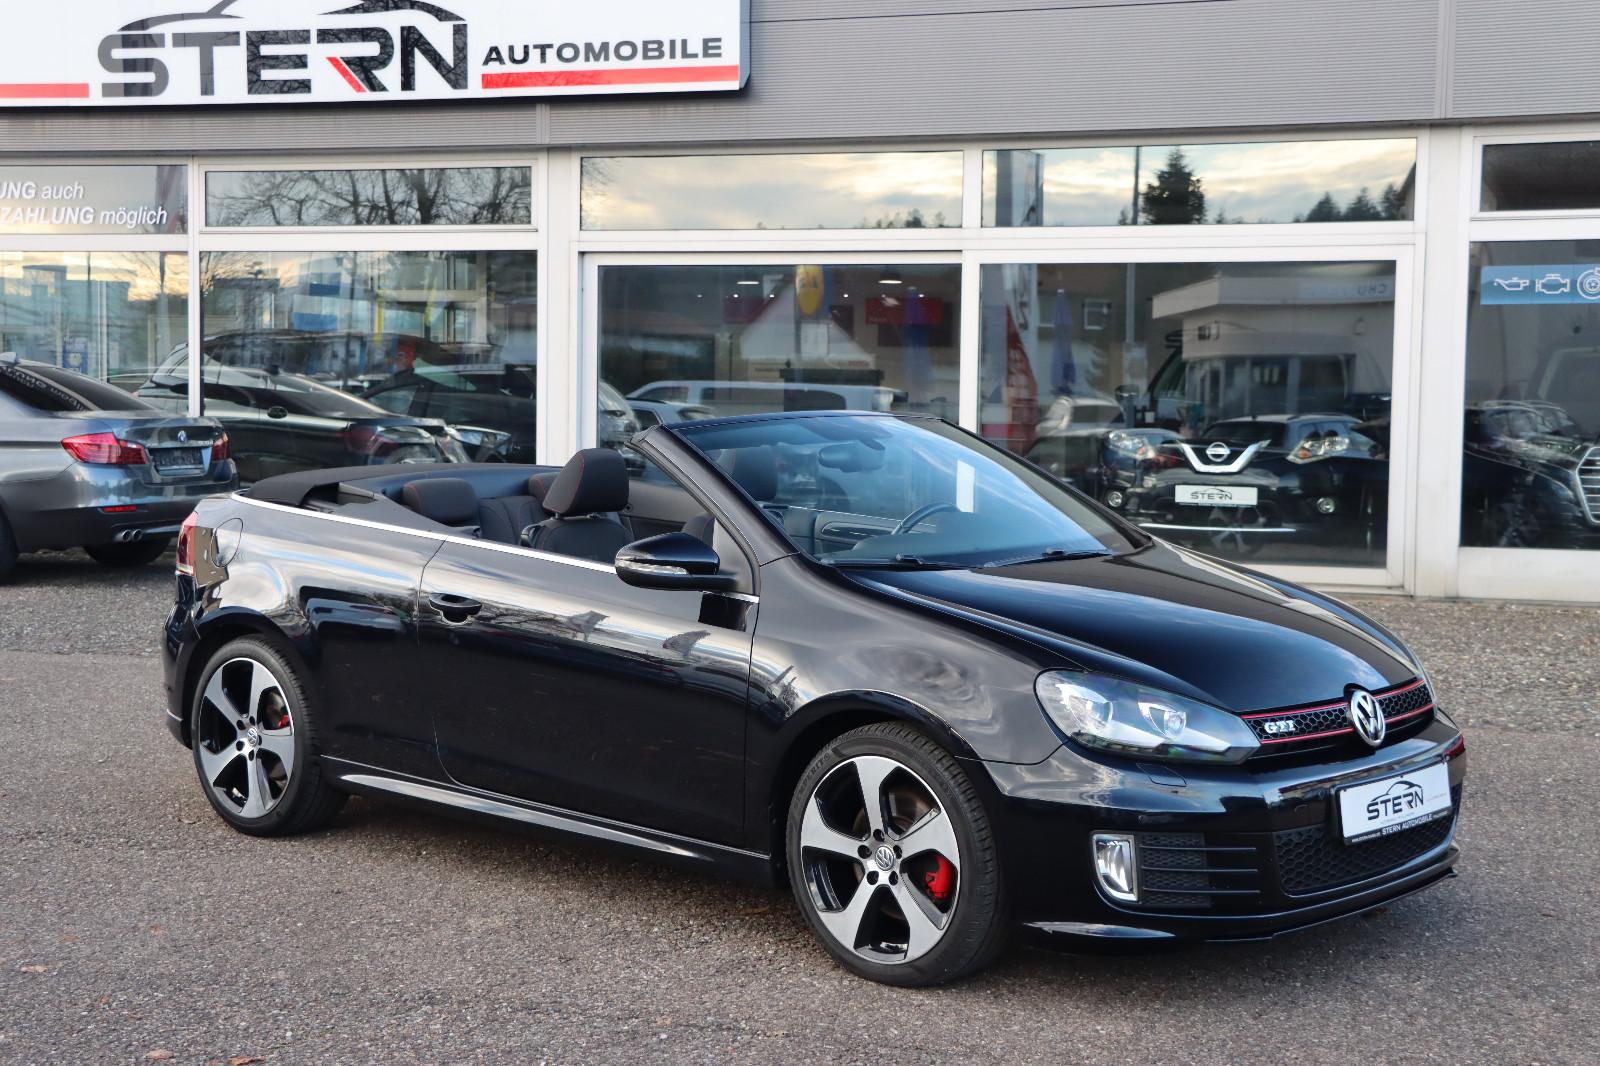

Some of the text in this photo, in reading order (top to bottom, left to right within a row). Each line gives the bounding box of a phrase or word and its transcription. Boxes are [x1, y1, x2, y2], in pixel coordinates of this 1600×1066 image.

[97, 23, 723, 98] STERN AUTOMOBILE
[41, 181, 84, 200] auch
[0, 205, 168, 229] ZAHLUNG möglich
[1190, 492, 1233, 500] STERN
[1263, 719, 1297, 735] GTI
[1366, 790, 1424, 821] STERN
[1381, 825, 1401, 836] STERN
[1401, 813, 1433, 830] AUTOMOBILE
